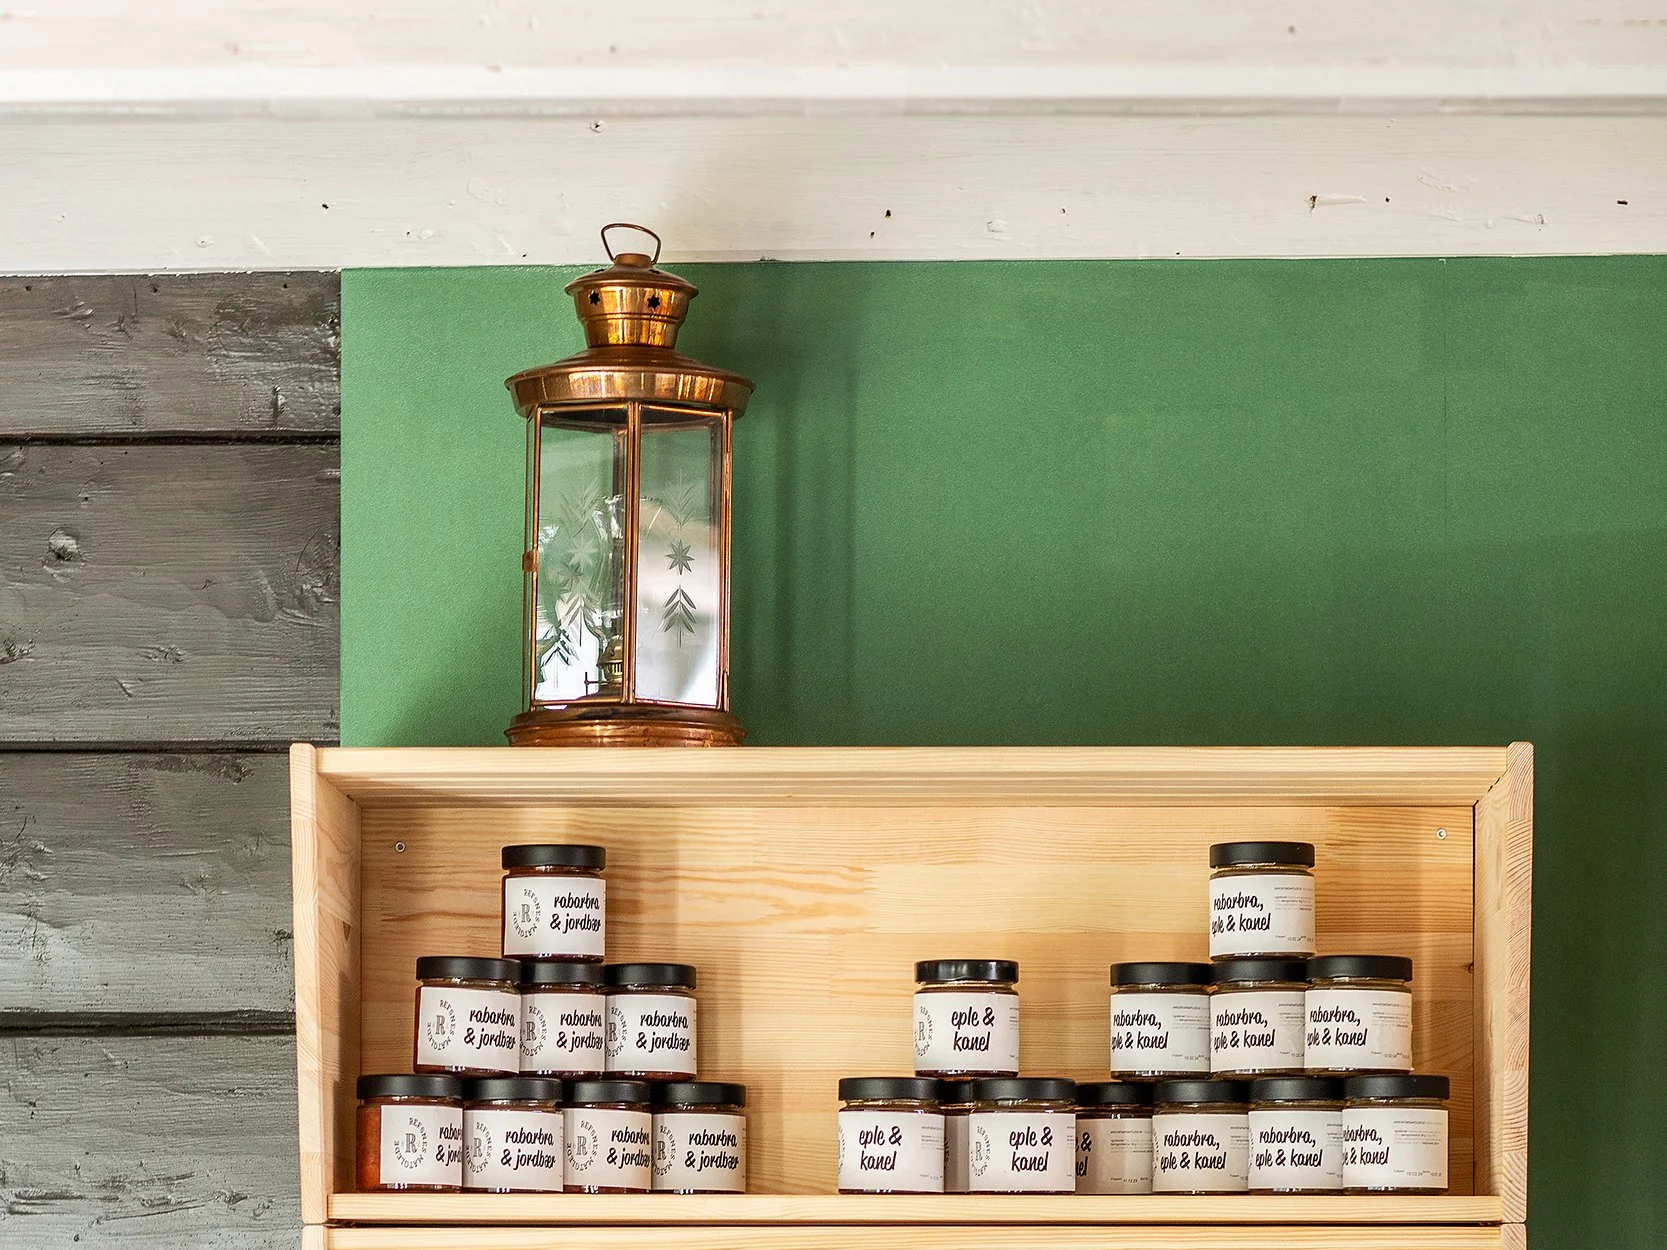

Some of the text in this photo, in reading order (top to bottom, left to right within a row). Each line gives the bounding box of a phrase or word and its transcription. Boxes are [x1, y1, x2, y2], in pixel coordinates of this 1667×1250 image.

[554, 892, 600, 910] rabarbra
[550, 913, 561, 931] &
[1226, 915, 1235, 932] &
[1239, 913, 1271, 932] kanel
[469, 1006, 515, 1027] rabarbra
[640, 1010, 688, 1029] rabarbra
[951, 1006, 979, 1030] eple
[982, 1006, 995, 1027] &
[1216, 1008, 1268, 1028] rabarbra,
[464, 1027, 476, 1046] &
[557, 1031, 567, 1049] &
[635, 1032, 647, 1050] &
[953, 1031, 991, 1052] kanel
[1124, 1031, 1169, 1049] & kanel
[1229, 1030, 1240, 1048] &
[1243, 1029, 1276, 1047] kanel
[1322, 1028, 1332, 1046] &
[1335, 1027, 1368, 1046] kanel
[505, 1127, 554, 1146] rabarbra
[688, 1129, 737, 1148] rabarbra
[859, 1125, 885, 1149] eple
[888, 1126, 902, 1146] &
[1009, 1126, 1037, 1150] eple
[1041, 1126, 1053, 1146] &
[1164, 1130, 1220, 1150] rabarbra,
[1260, 1126, 1316, 1147] rabarbra,
[435, 1144, 444, 1162] &
[501, 1148, 556, 1170] & jordbær
[606, 1147, 618, 1165] &
[684, 1150, 739, 1172] & jordbær
[860, 1150, 897, 1171] kanel
[1012, 1151, 1049, 1172] kanel
[1180, 1151, 1190, 1169] &
[1194, 1151, 1226, 1170] kanel
[1275, 1149, 1286, 1167] &
[1290, 1148, 1323, 1167] kanel
[1350, 1147, 1390, 1165] & kanel
